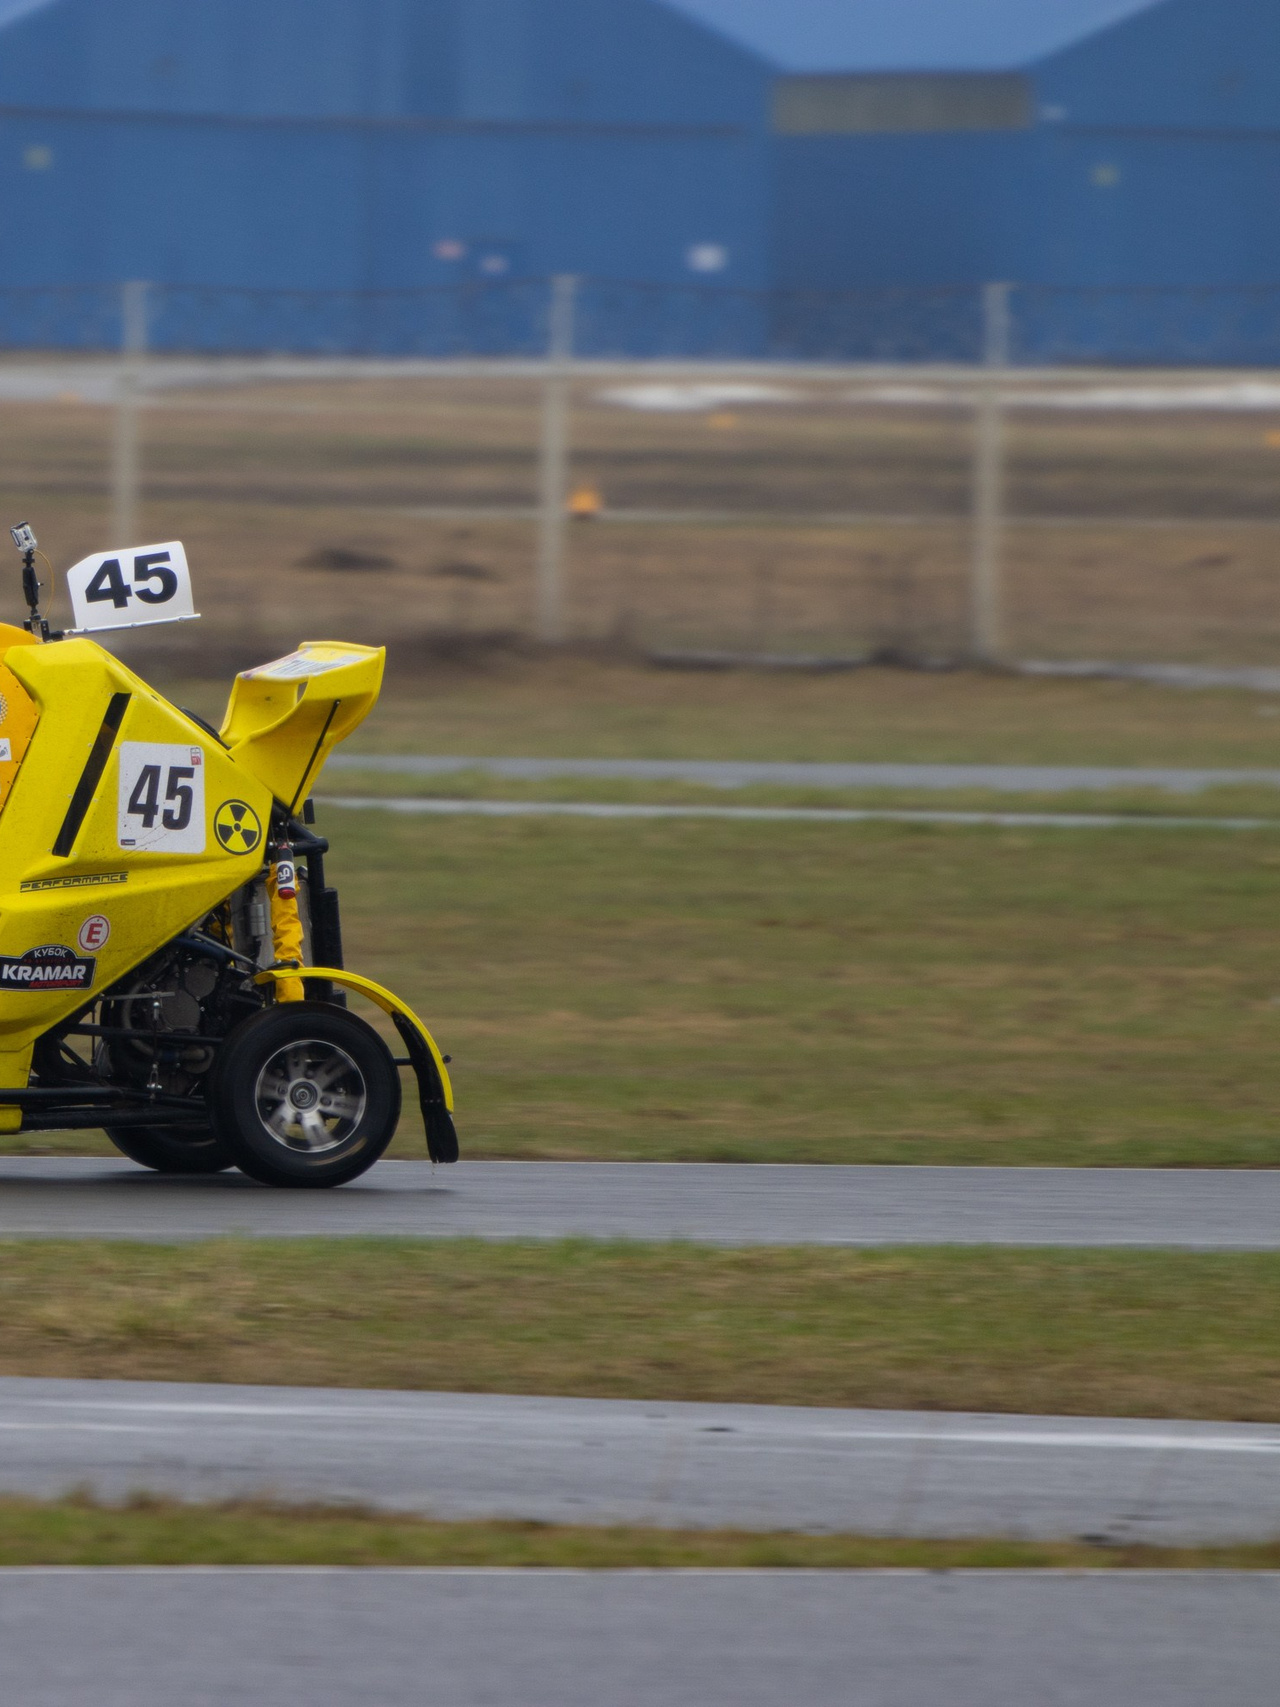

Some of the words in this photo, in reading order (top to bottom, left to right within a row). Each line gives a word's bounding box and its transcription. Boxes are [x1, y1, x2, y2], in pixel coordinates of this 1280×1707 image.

[85, 551, 177, 609] 45
[127, 765, 195, 830] 45
[20, 873, 128, 890] PERFORMANCE
[86, 923, 103, 943] E
[34, 947, 68, 958] КУБОК
[1, 964, 86, 981] KRAMAR
